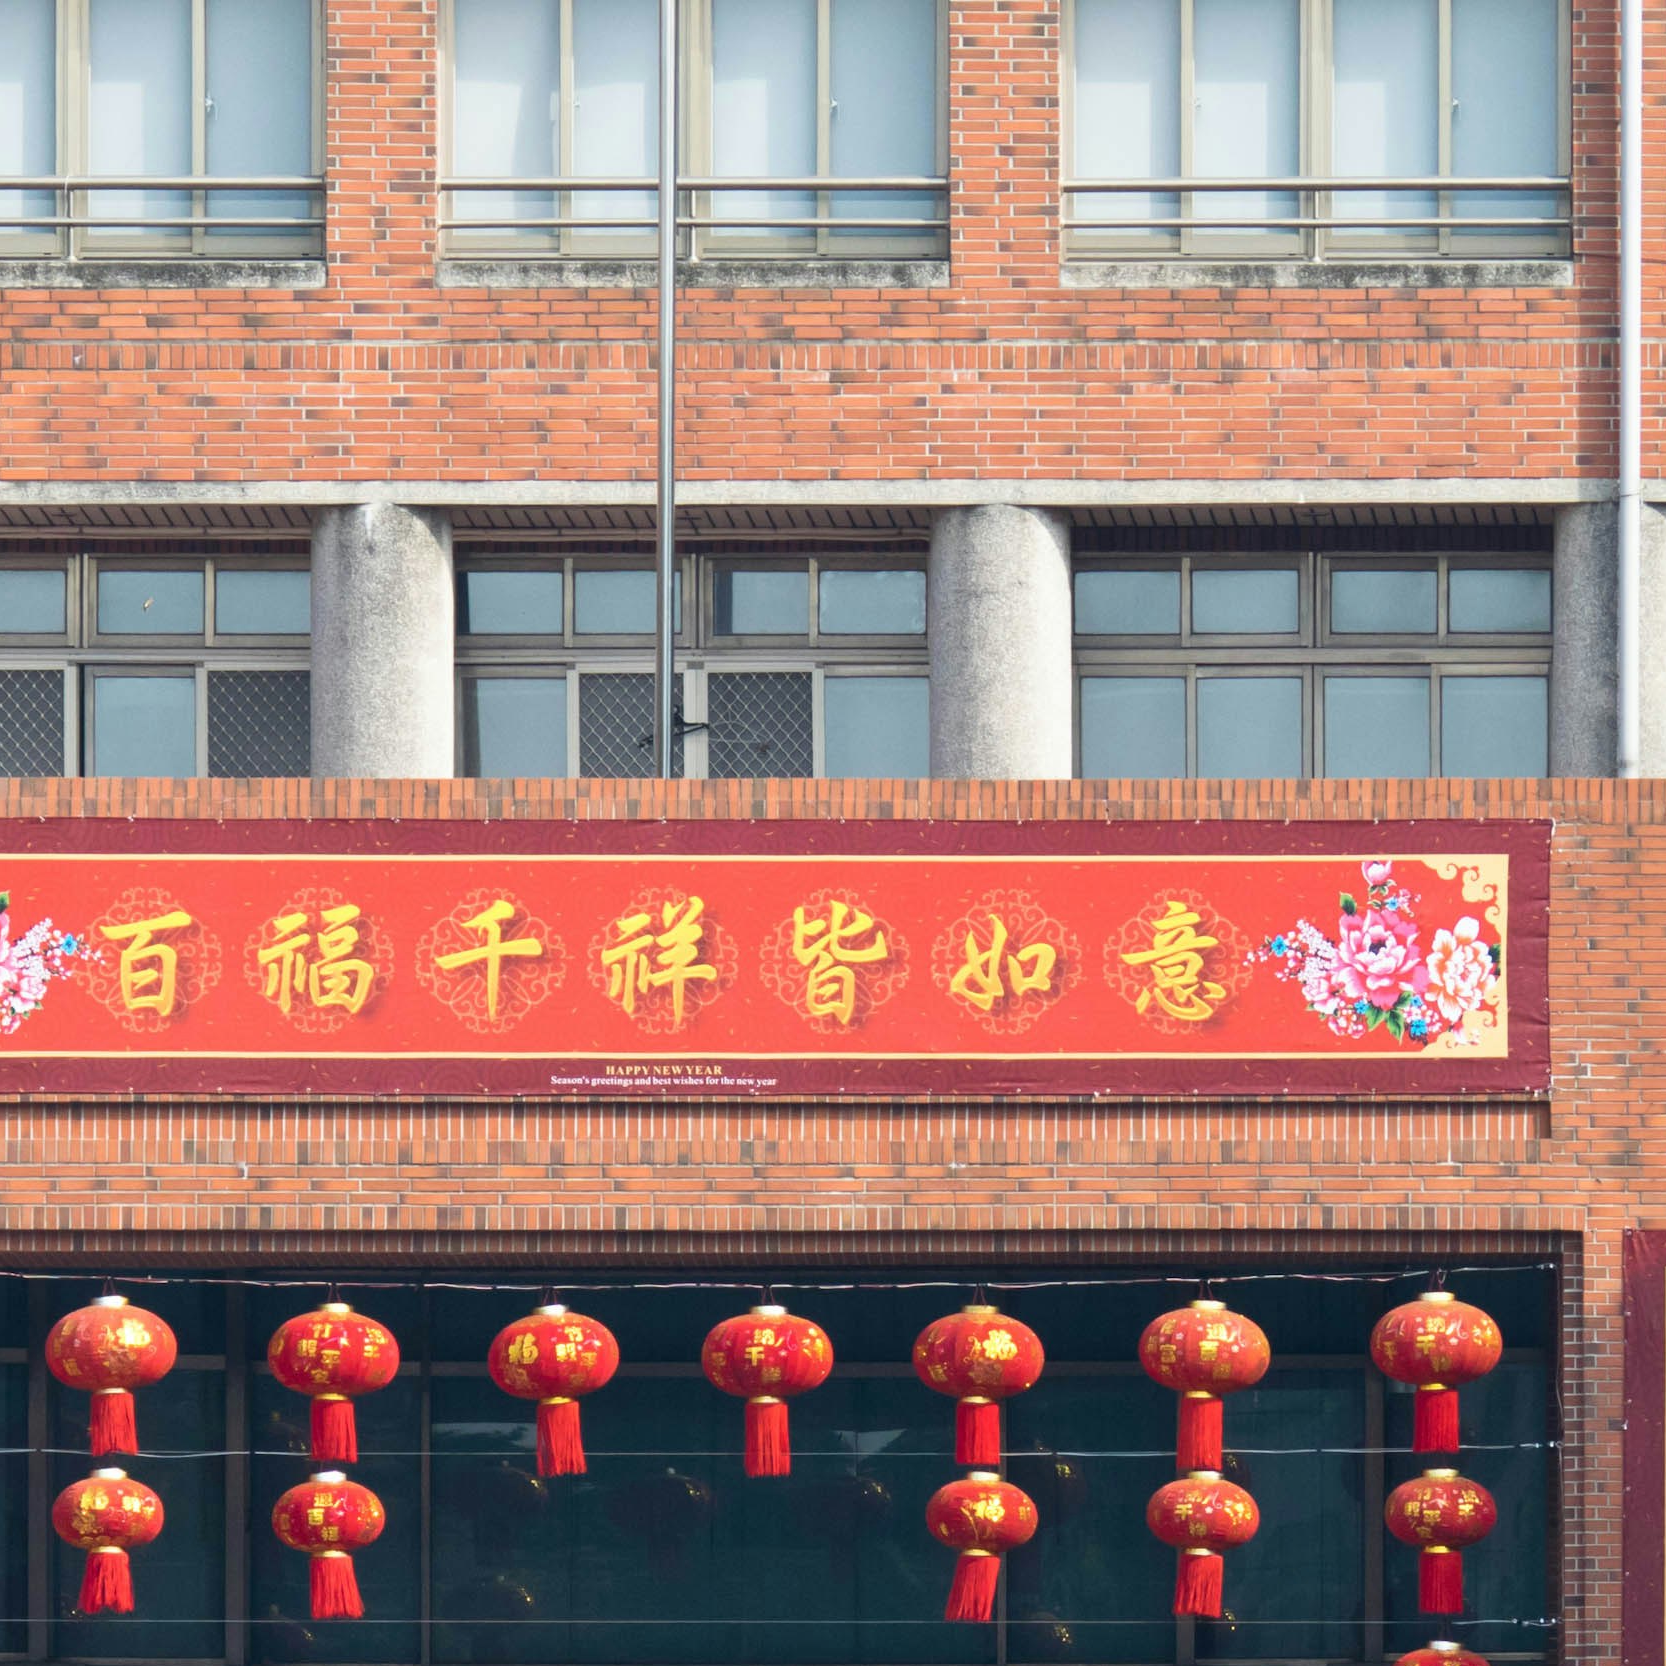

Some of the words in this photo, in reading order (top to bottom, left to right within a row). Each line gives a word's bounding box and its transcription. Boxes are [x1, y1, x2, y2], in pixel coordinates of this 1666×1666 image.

[100, 895, 1228, 1027] 百福千祥皆如意
[606, 1065, 650, 1075] HAPPY
[653, 1065, 683, 1075] NEW
[686, 1065, 723, 1075] YEAR
[550, 1075, 590, 1085] Season's
[591, 1076, 633, 1087] greetings
[635, 1075, 651, 1085] and
[653, 1075, 671, 1085] best
[673, 1075, 704, 1086] wishes
[705, 1076, 719, 1086] for
[720, 1076, 734, 1086] the
[735, 1078, 754, 1086] new
[754, 1078, 777, 1088] year
